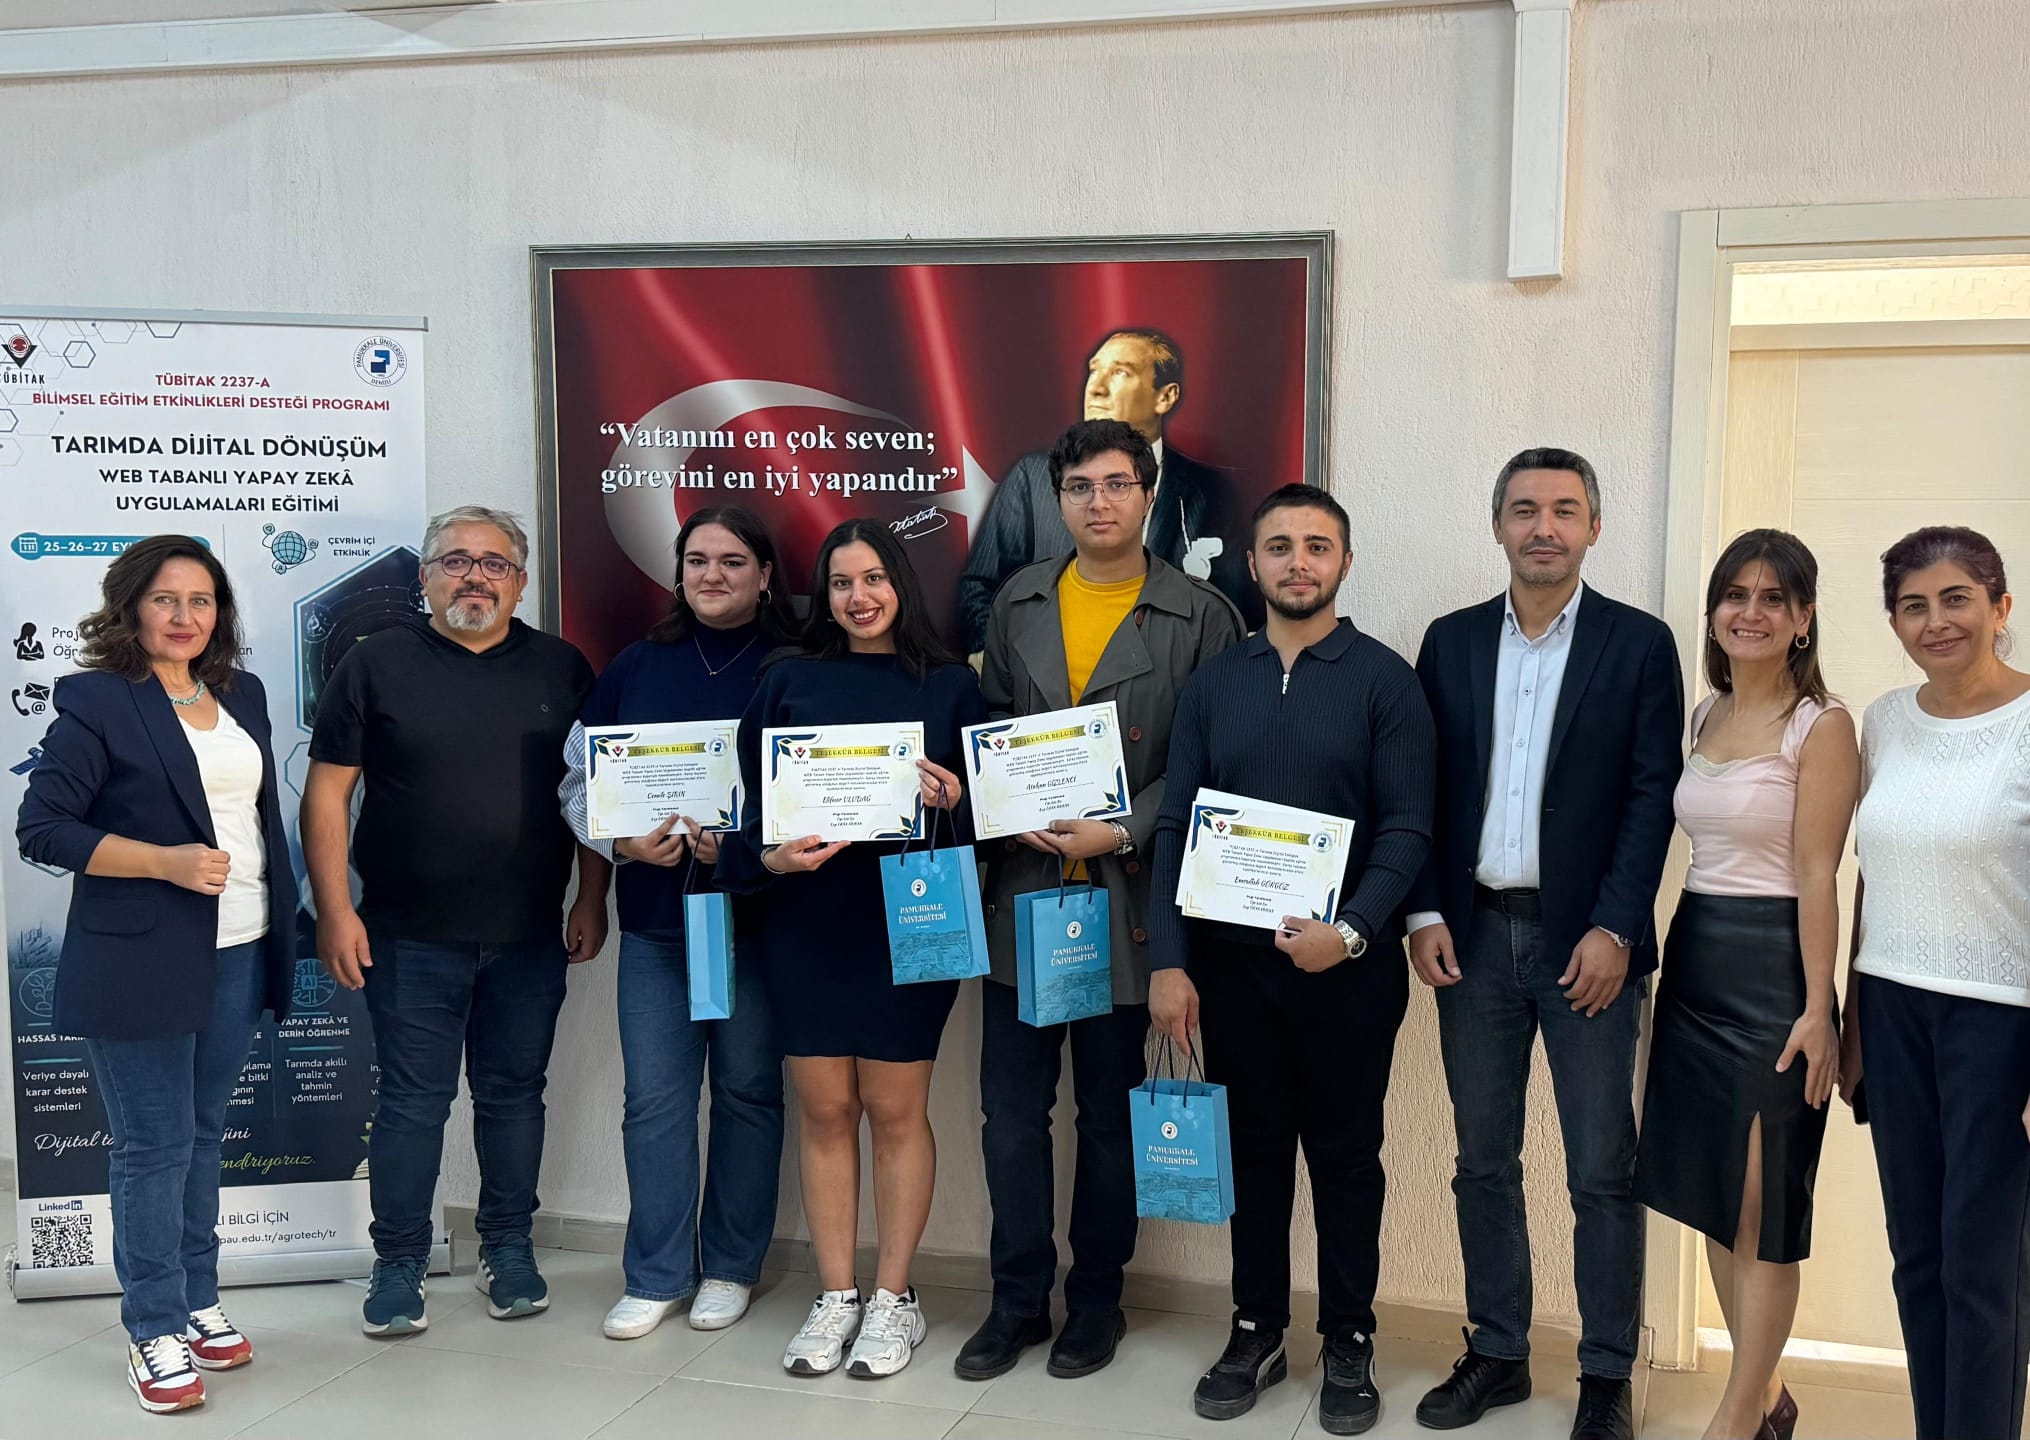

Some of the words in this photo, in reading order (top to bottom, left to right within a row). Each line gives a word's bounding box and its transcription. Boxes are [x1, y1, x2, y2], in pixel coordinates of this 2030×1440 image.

[0, 372, 45, 384] ÜBİTAK
[156, 374, 216, 387] TÜBİTAK
[221, 376, 270, 388] 2237-A
[32, 391, 95, 405] BİLİMSEL
[100, 392, 148, 406] EĞİTİM
[153, 394, 245, 408] ETKİNLİKLERİ
[250, 395, 308, 410] DESTEĞİ
[312, 398, 390, 412] PROGRAMI
[744, 430, 777, 449] en
[786, 425, 836, 455] çok
[845, 432, 935, 456] seven;
[52, 436, 164, 456] TARIMDA
[172, 434, 255, 457] DİJİTAL
[263, 434, 387, 462] DÖNÜŞÜM
[99, 468, 142, 484] WEB
[149, 469, 227, 485] TABANLI
[233, 470, 298, 486] YAPAY
[305, 468, 354, 487] ZEKÂ
[600, 464, 714, 494] görevini
[724, 471, 755, 490] en
[766, 466, 800, 498] iyi
[116, 496, 265, 512] UYGULAMALARI
[271, 494, 340, 512] EĞİTİMİ
[328, 536, 361, 546] ÇEVRİM
[364, 536, 375, 546] İÇİ
[333, 548, 370, 556] ETKİNLİK
[52, 627, 80, 641] Proj
[900, 903, 943, 914] PAMUKKALE
[898, 912, 946, 924] ÜNİVERSİTESİ
[337, 1016, 348, 1024] VE
[18, 1034, 56, 1044] HASSAS
[278, 1029, 304, 1038] DERİN
[307, 1028, 351, 1038] ÖĞRENME
[284, 1058, 322, 1068] Tarımda
[325, 1058, 348, 1066] akıllı
[22, 1072, 56, 1082] Veriye
[59, 1069, 90, 1080] dayalı
[248, 1072, 269, 1082] bitki
[296, 1070, 322, 1079] analiz
[26, 1088, 52, 1096] karar
[54, 1085, 88, 1095] destek
[301, 1082, 332, 1090] tahmin
[292, 1092, 343, 1104] yöntemleri
[34, 1102, 82, 1112] sistemleri
[34, 1131, 102, 1157] Dijital
[1148, 1145, 1196, 1156] PAMUKKALE
[220, 1152, 316, 1175] endiriyoruz.
[1146, 1154, 1198, 1166] ÜNİVERSİTESİ
[229, 1210, 259, 1226] BİLGİ
[263, 1210, 290, 1226] İÇİN
[220, 1229, 337, 1246] pau.edu.tr/agrotech/tr
